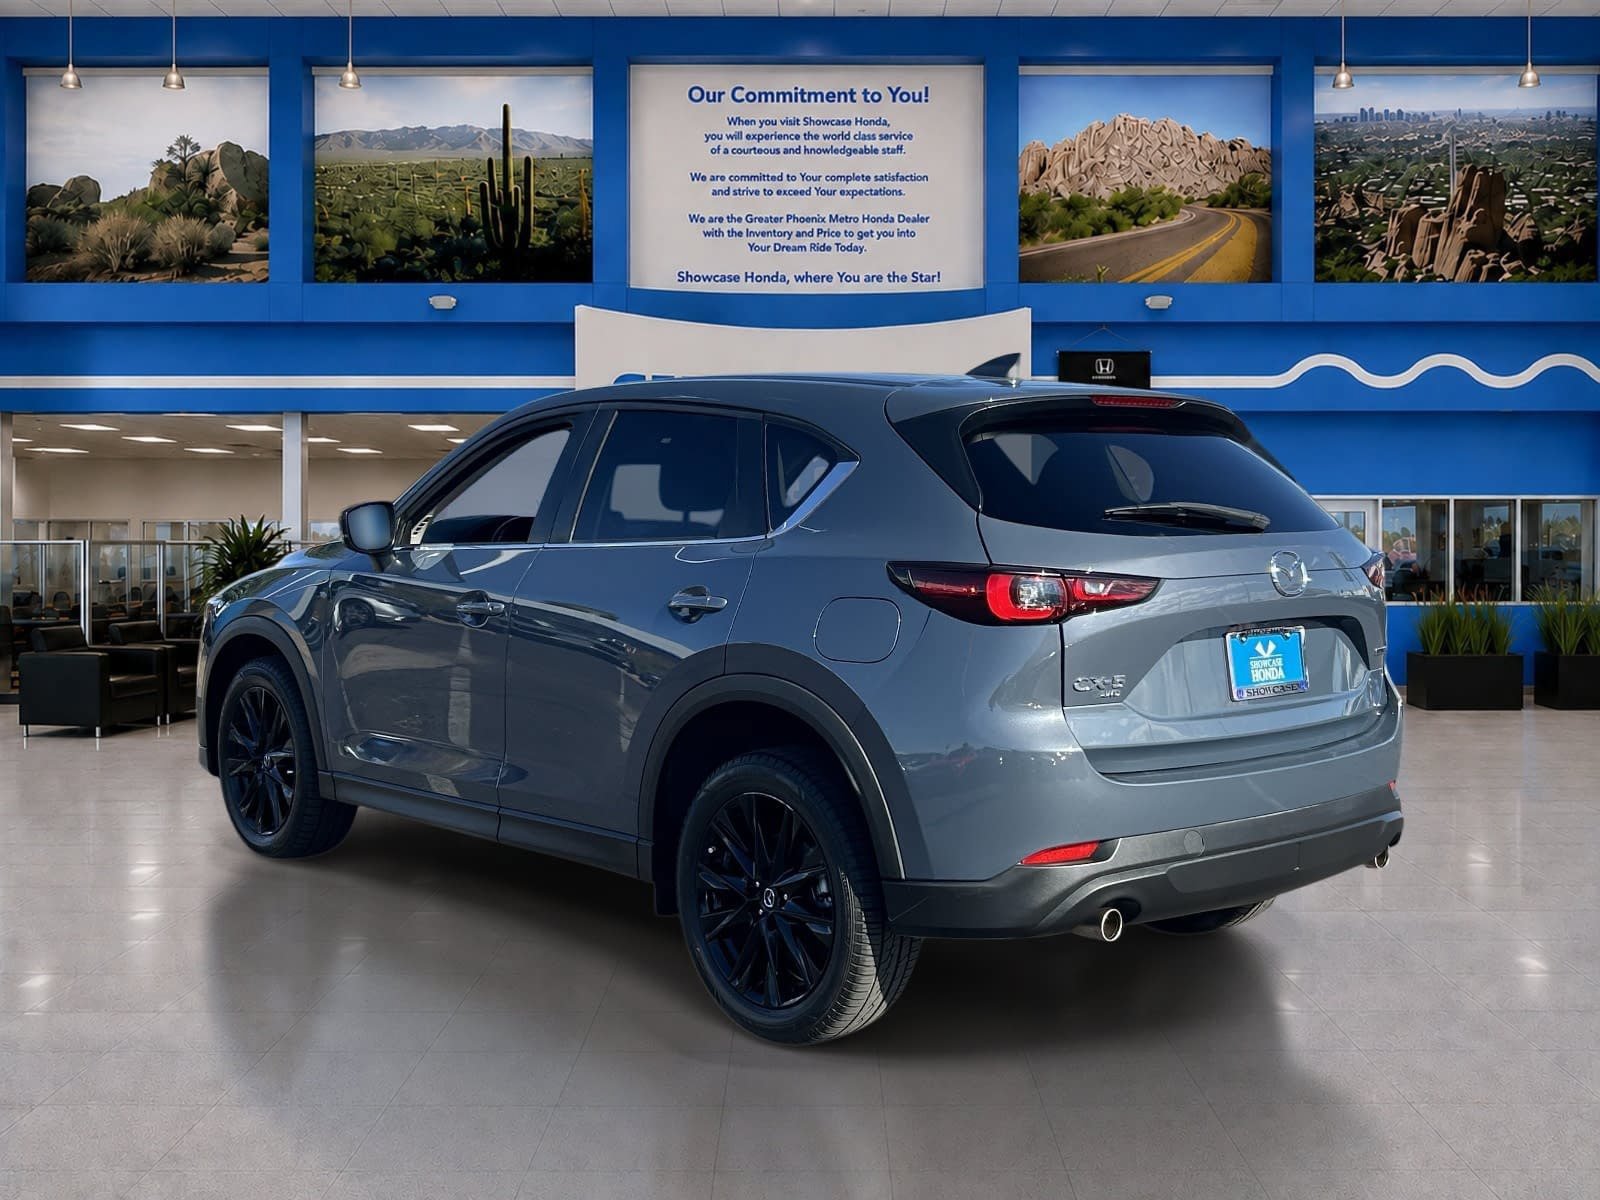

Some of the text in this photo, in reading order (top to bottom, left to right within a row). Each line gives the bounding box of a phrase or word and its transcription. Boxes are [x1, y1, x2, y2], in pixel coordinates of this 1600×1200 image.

[687, 85, 929, 104] Our Commitment to You!
[726, 116, 891, 129] When you visit Showcase Honda,
[704, 130, 914, 144] you will experience the world class service
[709, 144, 722, 155] of
[722, 147, 730, 155] a
[730, 146, 782, 156] courteous
[782, 144, 802, 155] and
[881, 144, 907, 155] staff.
[689, 171, 929, 185] We are committed to Your complete satisfaction
[711, 185, 906, 200] and strive to exceed Your expectations.
[688, 213, 931, 224] We are the Greater Phoenix Metro Honda Dealer
[702, 227, 917, 241] with the Inventory and Price to get you into
[747, 242, 868, 255] Your Dream Ride Today.
[676, 270, 941, 286] Showcase Honda, where You are the Star!
[1249, 657, 1284, 670] SHOWCASE
[1250, 666, 1286, 683] HONDA
[1073, 674, 1127, 692] CX-5
[1245, 683, 1298, 698] SHOWCASE
